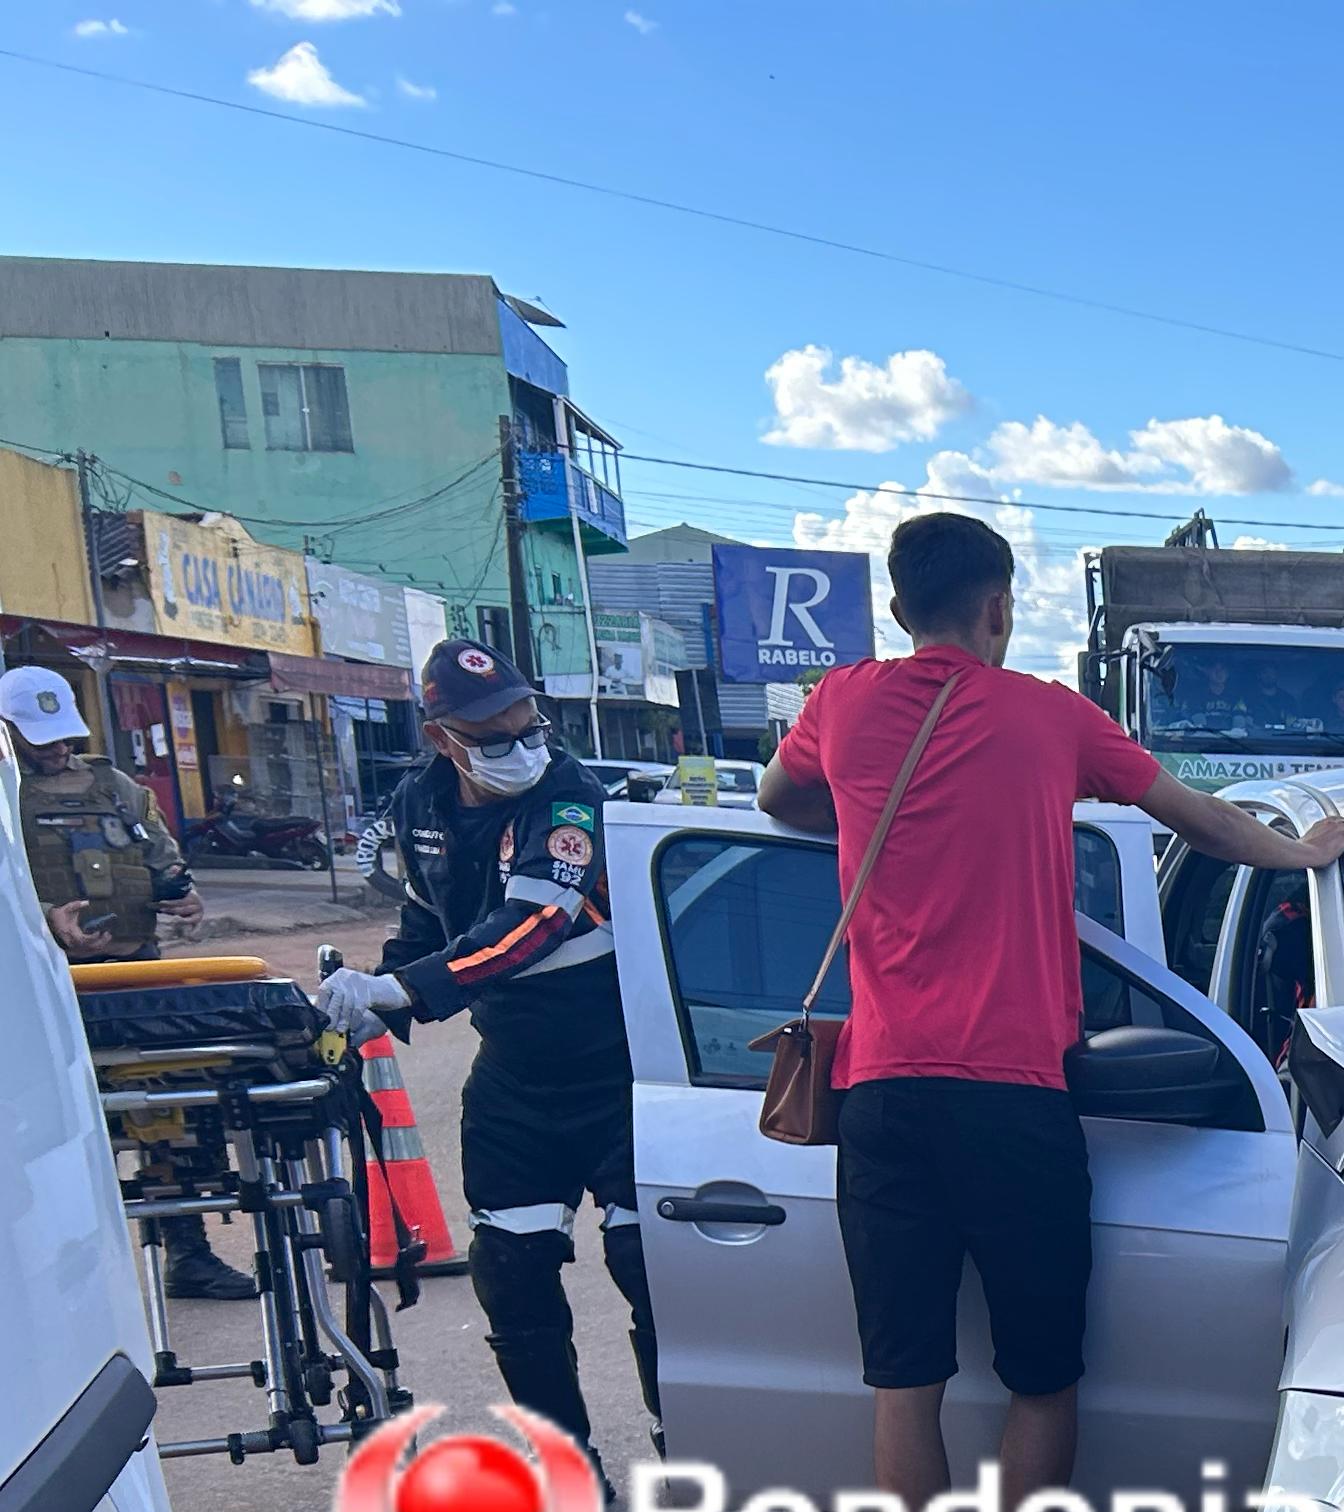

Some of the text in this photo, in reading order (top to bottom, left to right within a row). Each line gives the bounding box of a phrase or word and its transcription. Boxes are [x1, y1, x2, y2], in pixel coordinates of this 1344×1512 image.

[758, 566, 834, 648] R
[758, 648, 836, 666] RABELO
[1178, 759, 1274, 779] AMAZON
[552, 869, 582, 886] 192
[553, 861, 585, 877] SAMU
